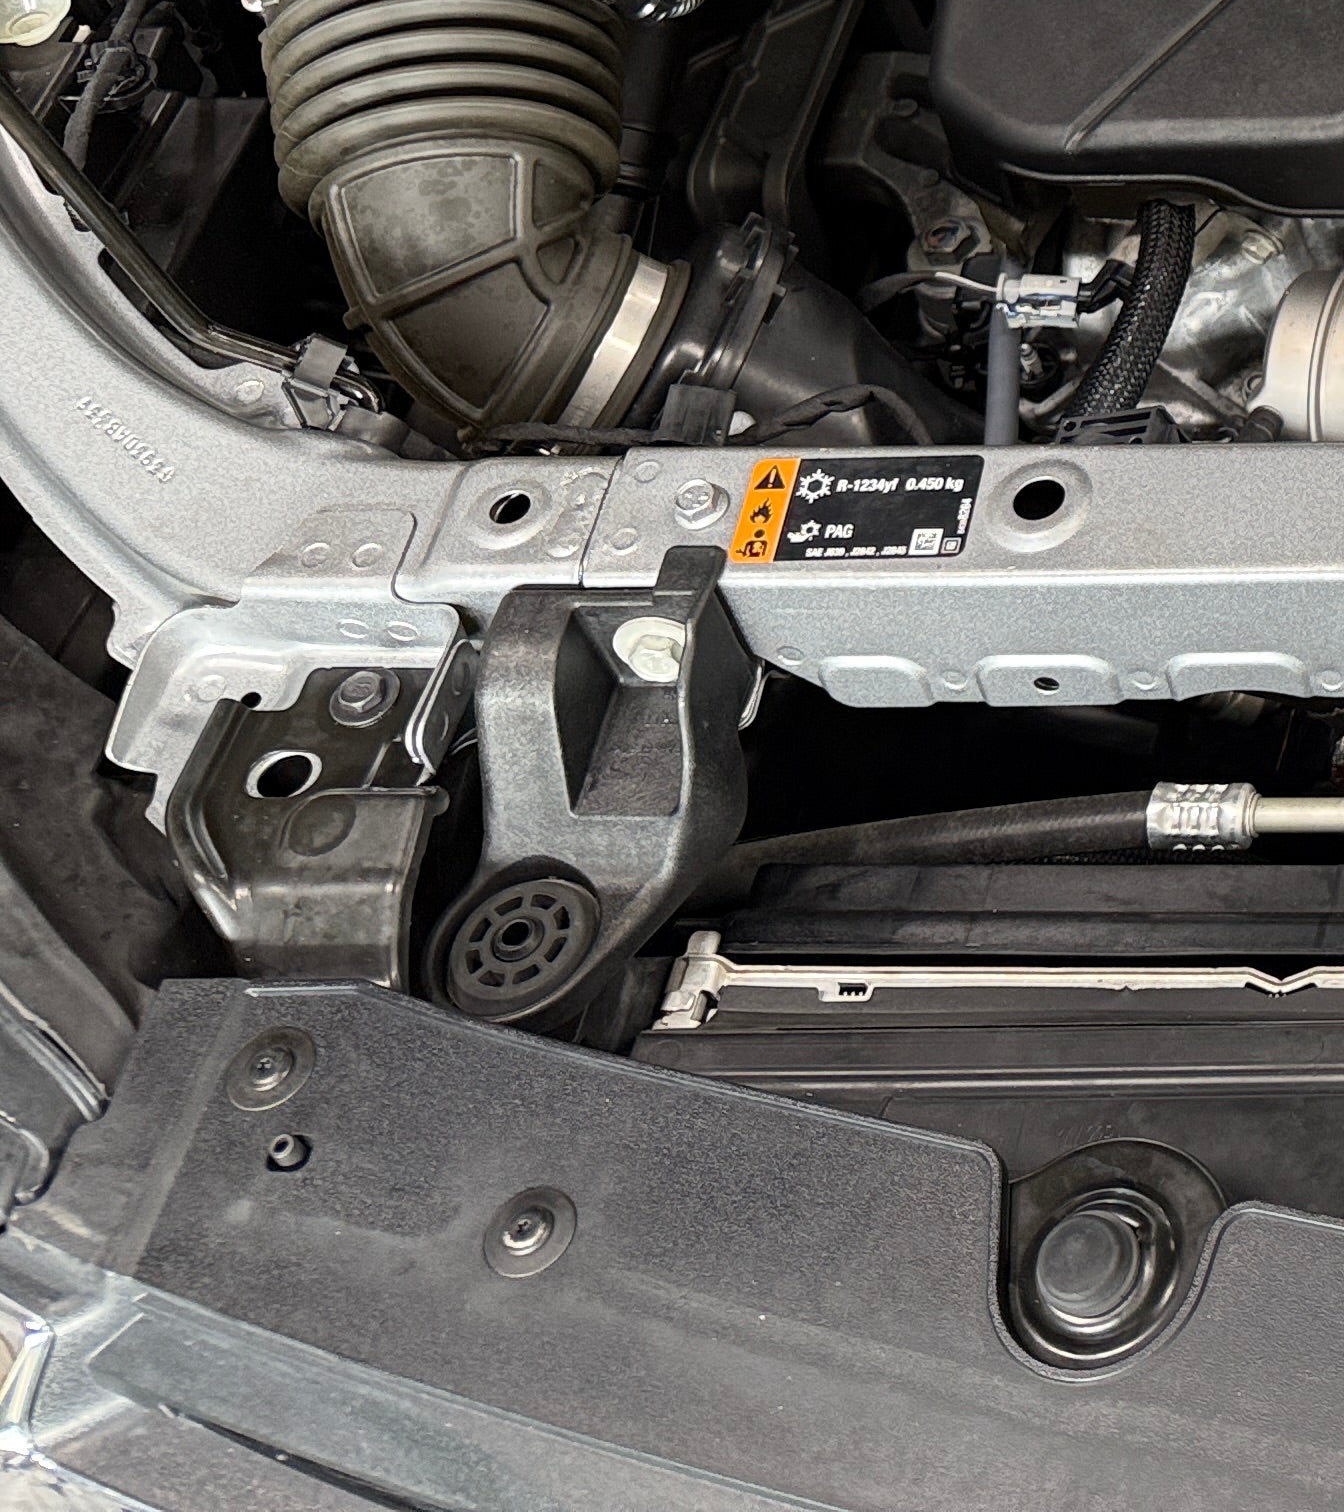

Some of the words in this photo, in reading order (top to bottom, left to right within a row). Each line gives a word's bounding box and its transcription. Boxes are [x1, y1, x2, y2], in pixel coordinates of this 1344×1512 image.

[835, 477, 899, 494] R-1234yf
[904, 477, 945, 492] 0.450
[945, 477, 964, 493] kg
[823, 524, 854, 539] PAG
[805, 547, 824, 558] SAE
